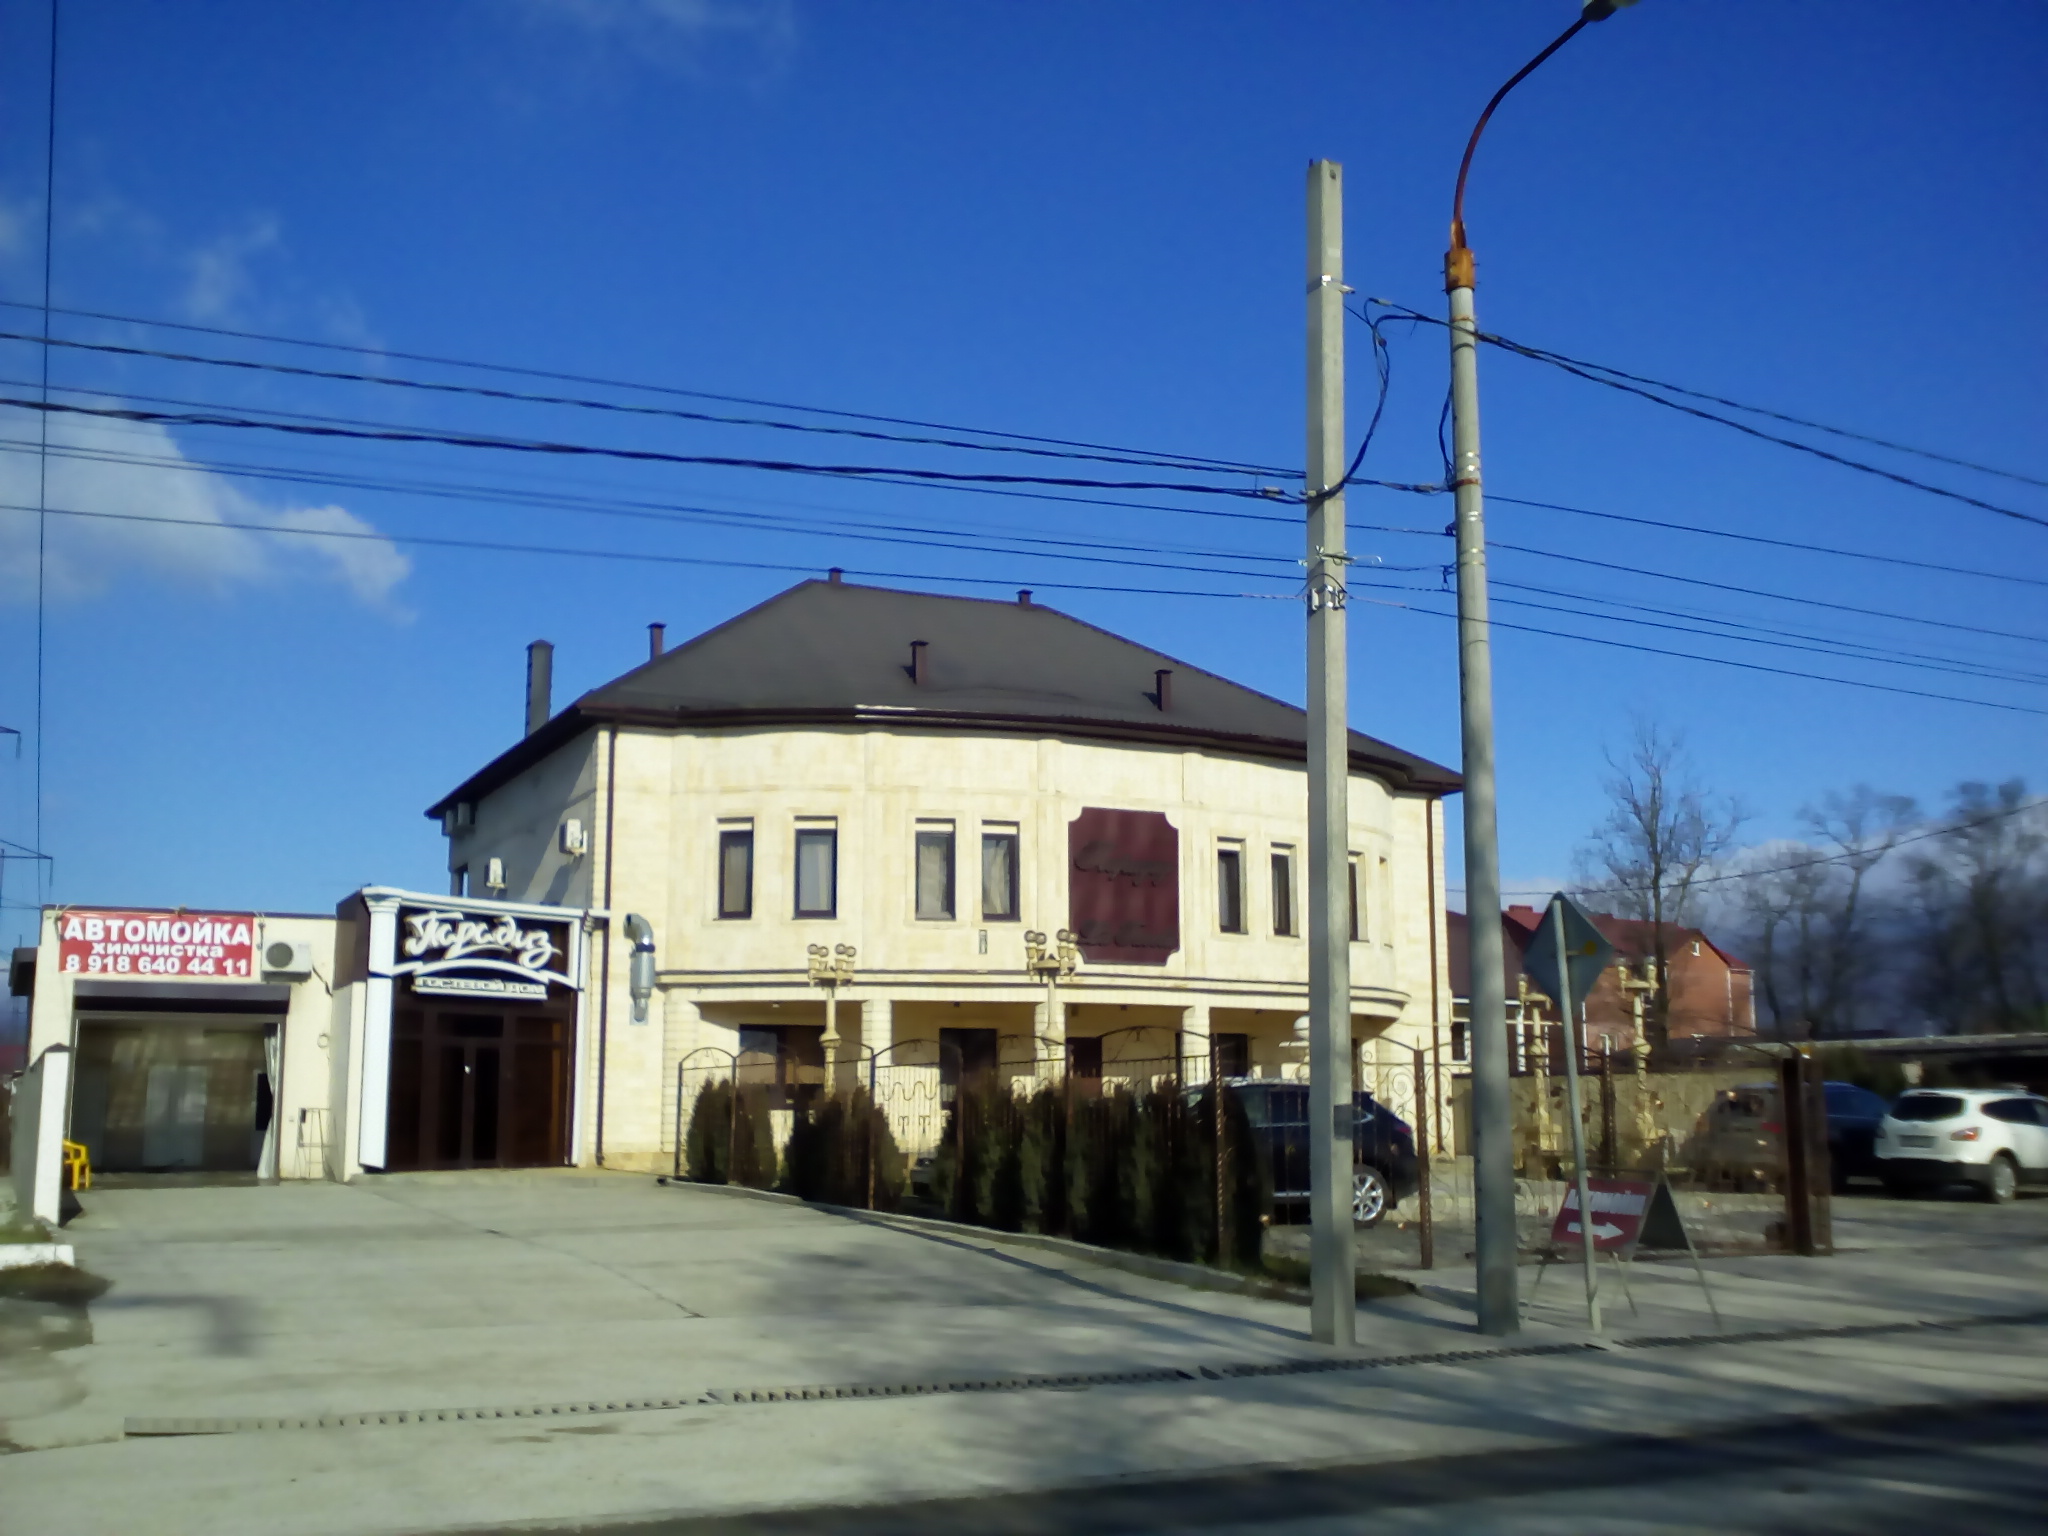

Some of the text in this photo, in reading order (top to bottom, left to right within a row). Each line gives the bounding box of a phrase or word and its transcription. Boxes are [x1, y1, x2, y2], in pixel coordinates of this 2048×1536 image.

[63, 917, 251, 945] АВТОМОЙКА
[403, 910, 563, 969] Парадиз
[91, 942, 224, 957] химчистка
[66, 954, 247, 975] 8 918 640 44 11
